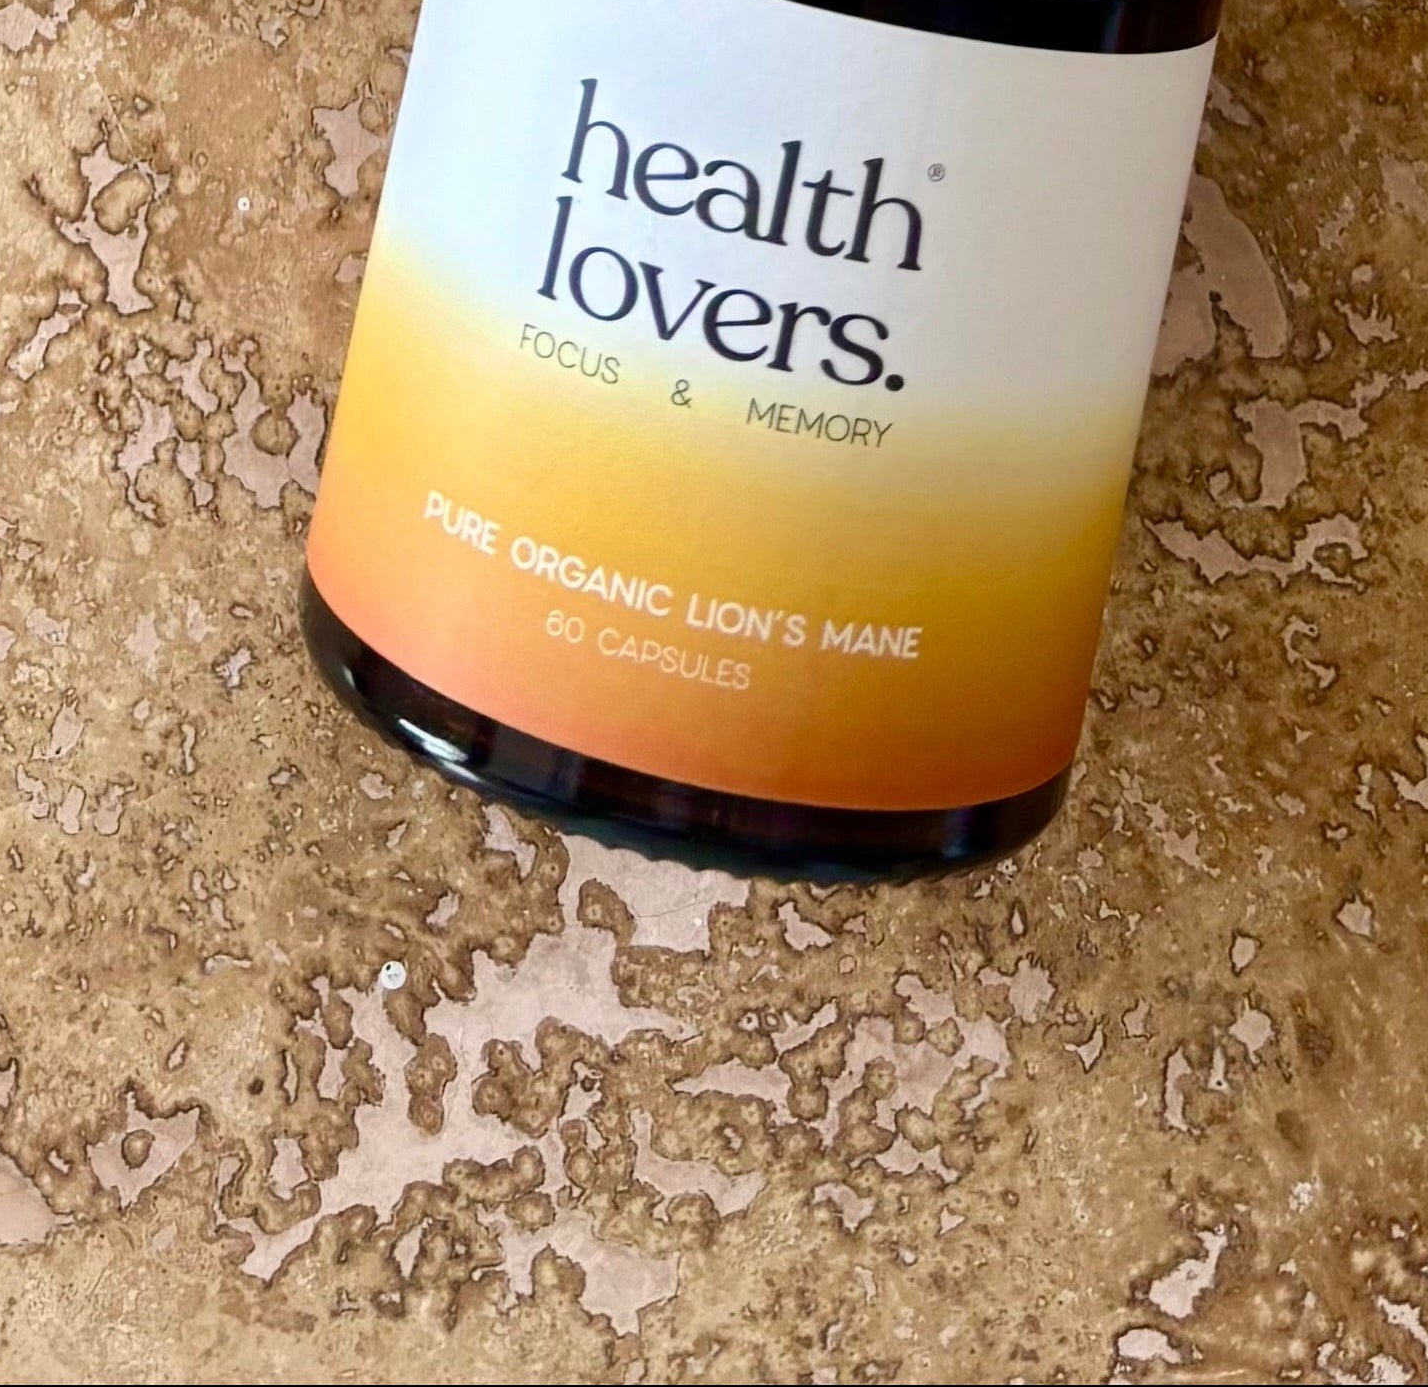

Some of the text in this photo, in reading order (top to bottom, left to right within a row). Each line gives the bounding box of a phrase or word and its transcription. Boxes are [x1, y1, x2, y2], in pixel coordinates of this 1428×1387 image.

[537, 196, 904, 391] lovers.
[520, 323, 892, 447] FOCUS & MEMORY
[424, 490, 923, 659] PURE ORGANIC LION'S MANE
[546, 609, 751, 691] 60 CAPSULES
